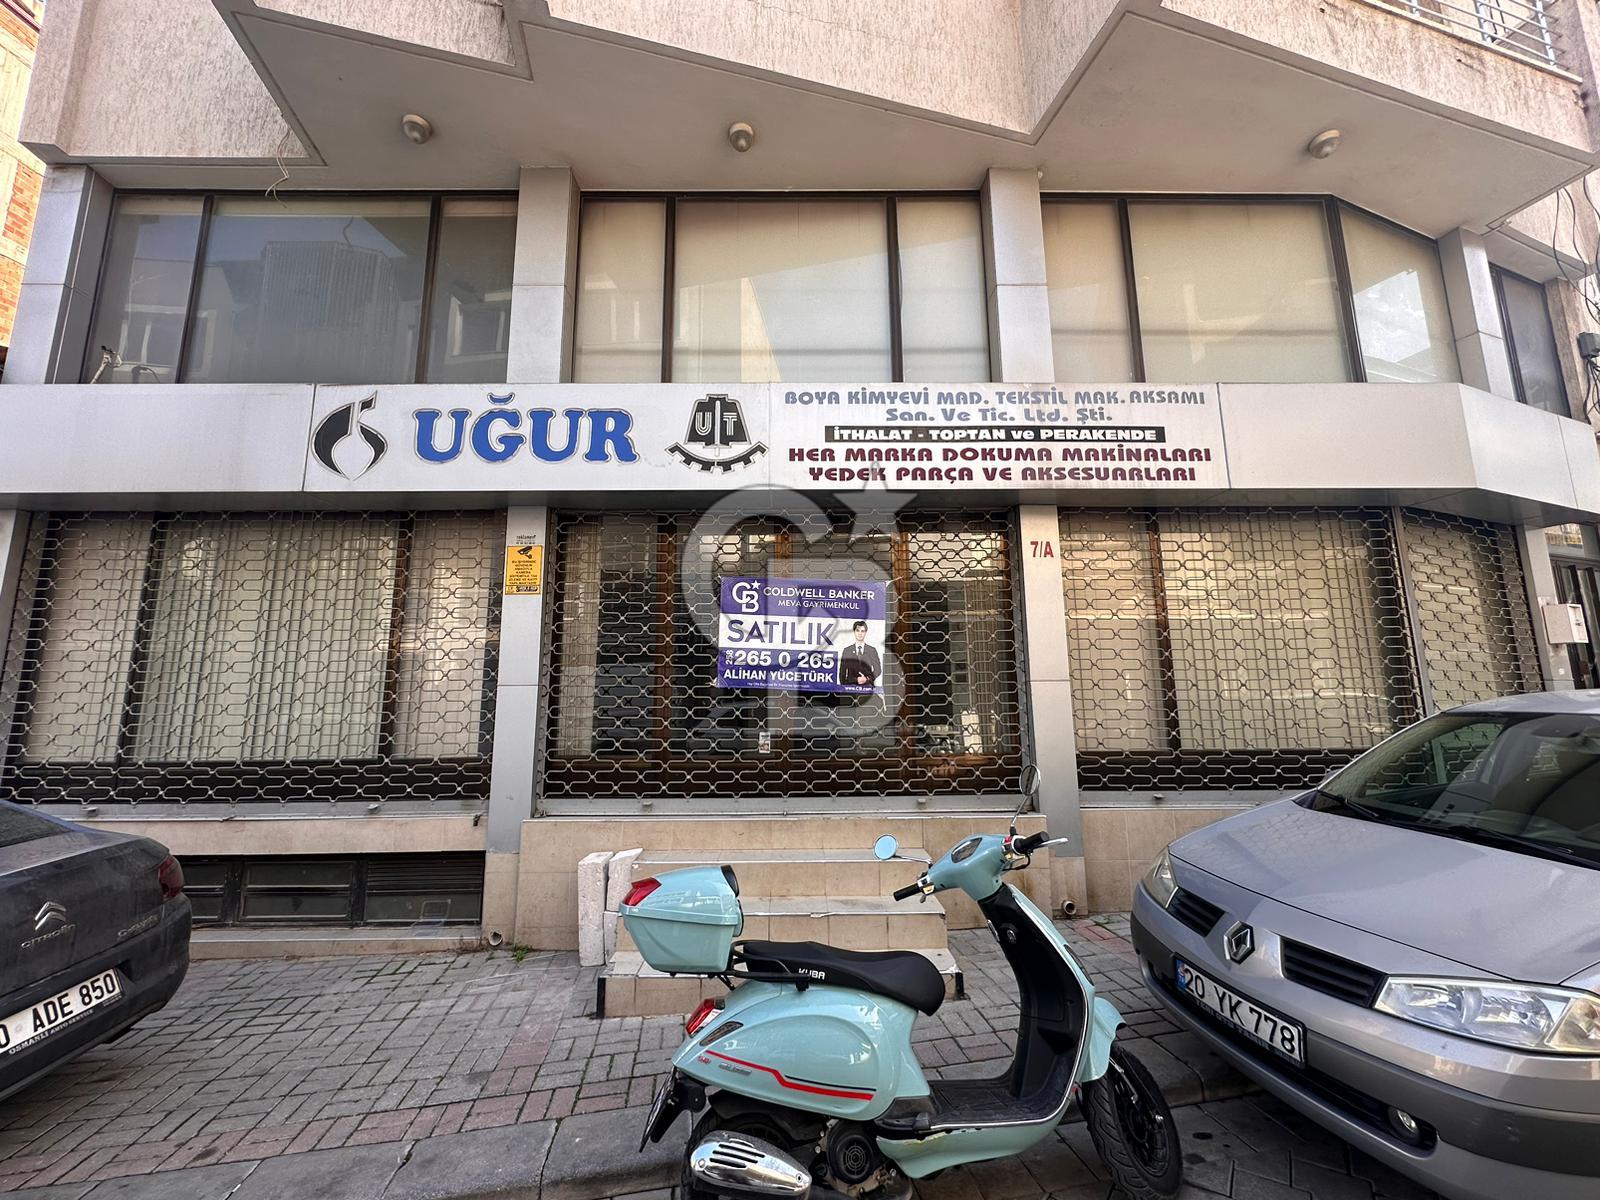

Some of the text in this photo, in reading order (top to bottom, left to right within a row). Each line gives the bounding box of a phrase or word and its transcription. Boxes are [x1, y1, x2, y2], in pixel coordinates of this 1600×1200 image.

[784, 387, 1206, 405] BOYA KİMYEVİ MAD. TEKSTİL MAK. AKSAMI
[885, 407, 1113, 424] San. Ve Tic. Ltd. Şti.
[411, 391, 641, 465] UĞUR
[833, 426, 913, 441] İTHALAT
[928, 429, 1006, 441] TOPTAN
[1010, 430, 1035, 441] ve
[1040, 429, 1157, 441] PERAKENDE
[788, 444, 1212, 462] HER MARKA DOKUMA MAKİNALARI
[808, 467, 1197, 484] YEDEK PARÇA VE AKSESUARLARI
[1030, 540, 1054, 558] 7/A
[763, 586, 826, 599] COLDWELL
[828, 589, 875, 601] BANKER
[777, 599, 802, 608] MEVA
[727, 619, 834, 646] SATILIK
[734, 650, 772, 667] 265
[778, 651, 791, 668] 0
[797, 652, 835, 669] 265
[723, 667, 834, 683] ALİHAN YÜCETÜRK
[32, 993, 74, 1034] ADE
[79, 973, 117, 1007] 850
[1184, 967, 1205, 1000] 20
[1213, 985, 1247, 1027] YK
[1248, 1006, 1296, 1055] 778
[8, 1030, 50, 1055] OSMANLI
